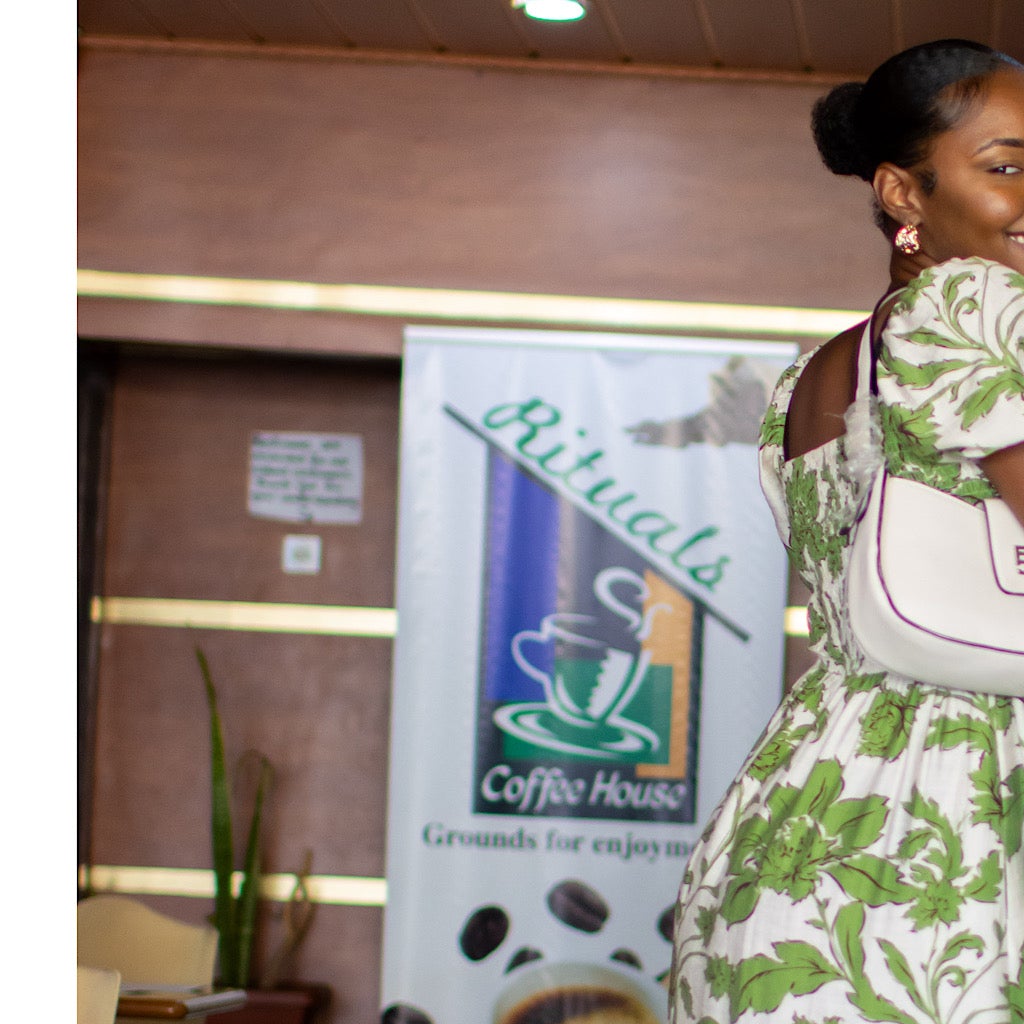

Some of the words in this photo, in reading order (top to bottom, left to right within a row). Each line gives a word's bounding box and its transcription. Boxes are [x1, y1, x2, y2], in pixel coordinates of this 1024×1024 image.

[483, 397, 732, 593] Rituals
[481, 764, 586, 813] Coffee
[590, 770, 688, 811] House
[422, 822, 538, 851] Grounds
[547, 829, 585, 853] for
[592, 832, 697, 862] enjoym
